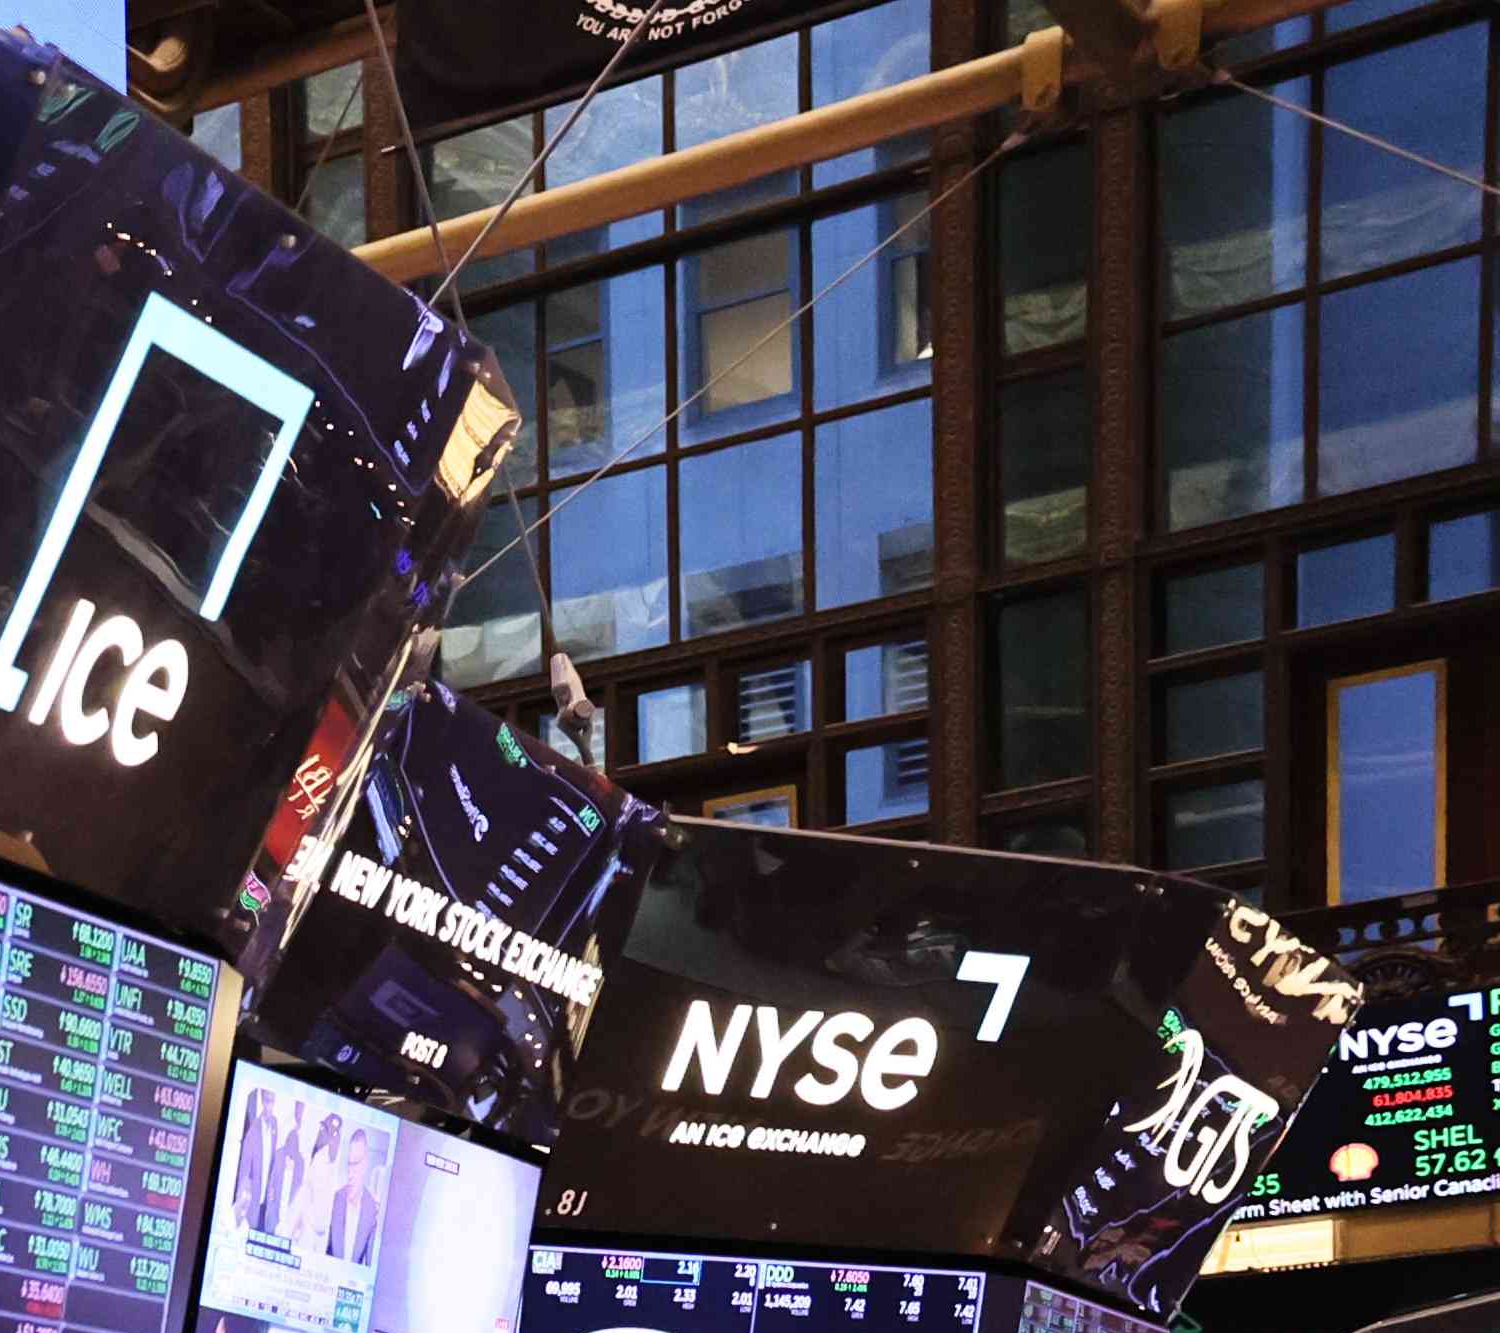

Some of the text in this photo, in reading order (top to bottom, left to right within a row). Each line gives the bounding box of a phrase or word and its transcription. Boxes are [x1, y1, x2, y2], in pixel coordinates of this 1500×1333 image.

[576, 0, 750, 42] YOU AR NOT FORG
[331, 851, 603, 1007] NEW YORK STOCK EXCHANGE
[1363, 1067, 1451, 1089] 479,512,955
[1364, 1104, 1453, 1126] 412,622,434
[669, 1121, 703, 1145] AN
[1414, 1124, 1483, 1150] SHEL
[1415, 1149, 1486, 1177] 57.62
[557, 1189, 587, 1216] 8J
[1269, 1195, 1320, 1215] Sheet
[1324, 1191, 1365, 1209] with
[1370, 1184, 1429, 1204] Senior
[766, 1265, 794, 1282] DDD
